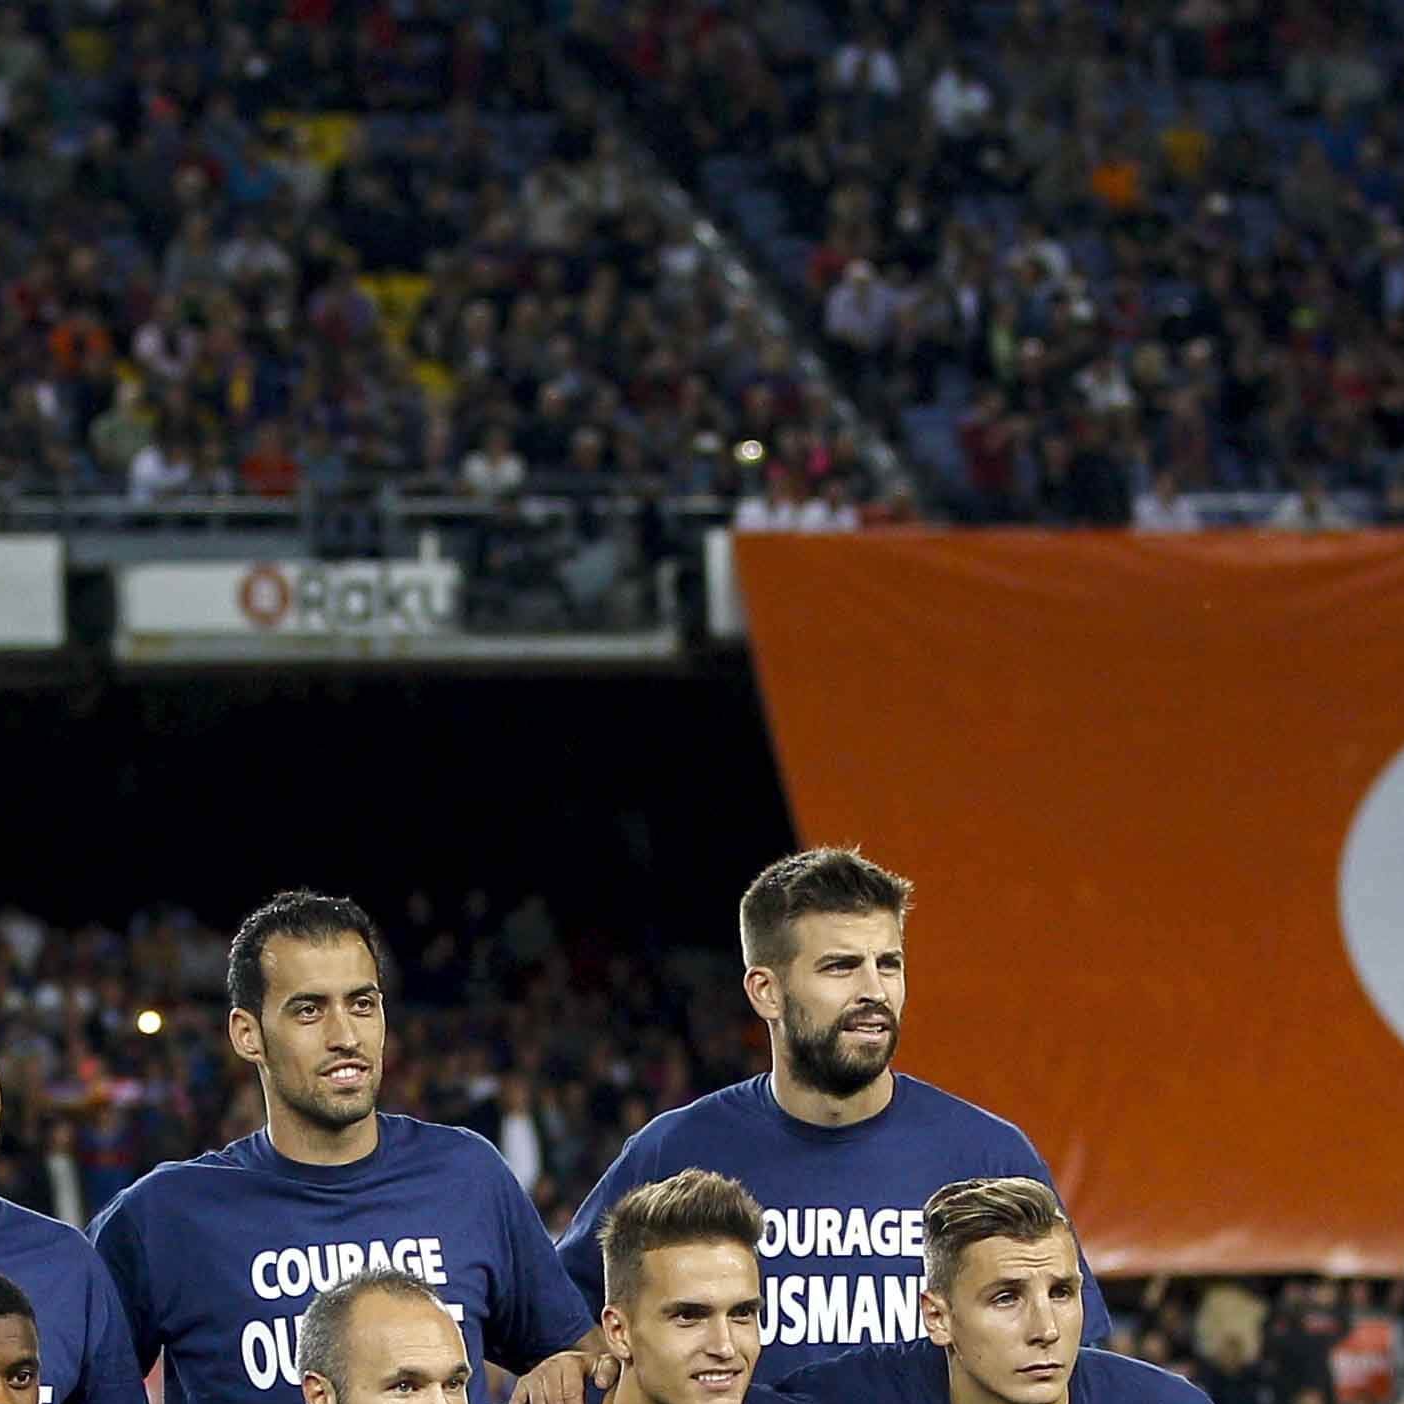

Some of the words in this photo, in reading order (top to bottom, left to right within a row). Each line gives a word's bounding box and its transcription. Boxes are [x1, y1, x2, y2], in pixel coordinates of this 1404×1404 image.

[299, 562, 457, 626] Raku
[757, 1208, 925, 1258] OURAGE
[757, 1275, 930, 1346] USMAN
